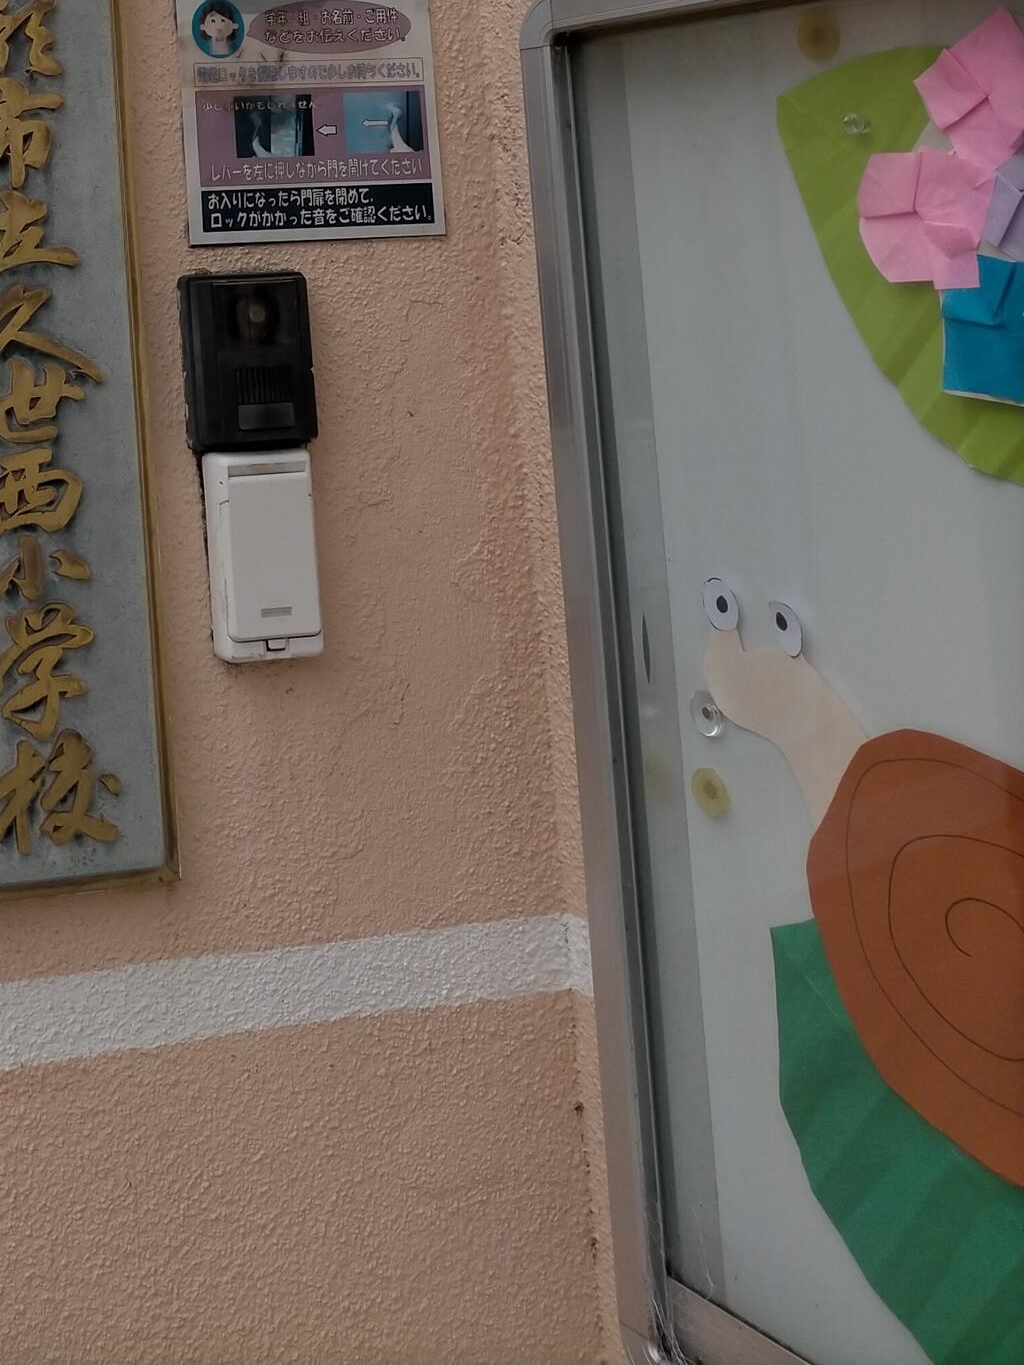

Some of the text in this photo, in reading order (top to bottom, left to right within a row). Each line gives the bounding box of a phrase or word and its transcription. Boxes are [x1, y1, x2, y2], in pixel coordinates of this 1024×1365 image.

[264, 7, 399, 26] 学年・組・お名前・ご用件
[264, 27, 406, 44] などをお伝えください。
[202, 100, 316, 112] 少しいかもしれせん
[210, 205, 432, 229] ロックがかかった音をご確認ください。
